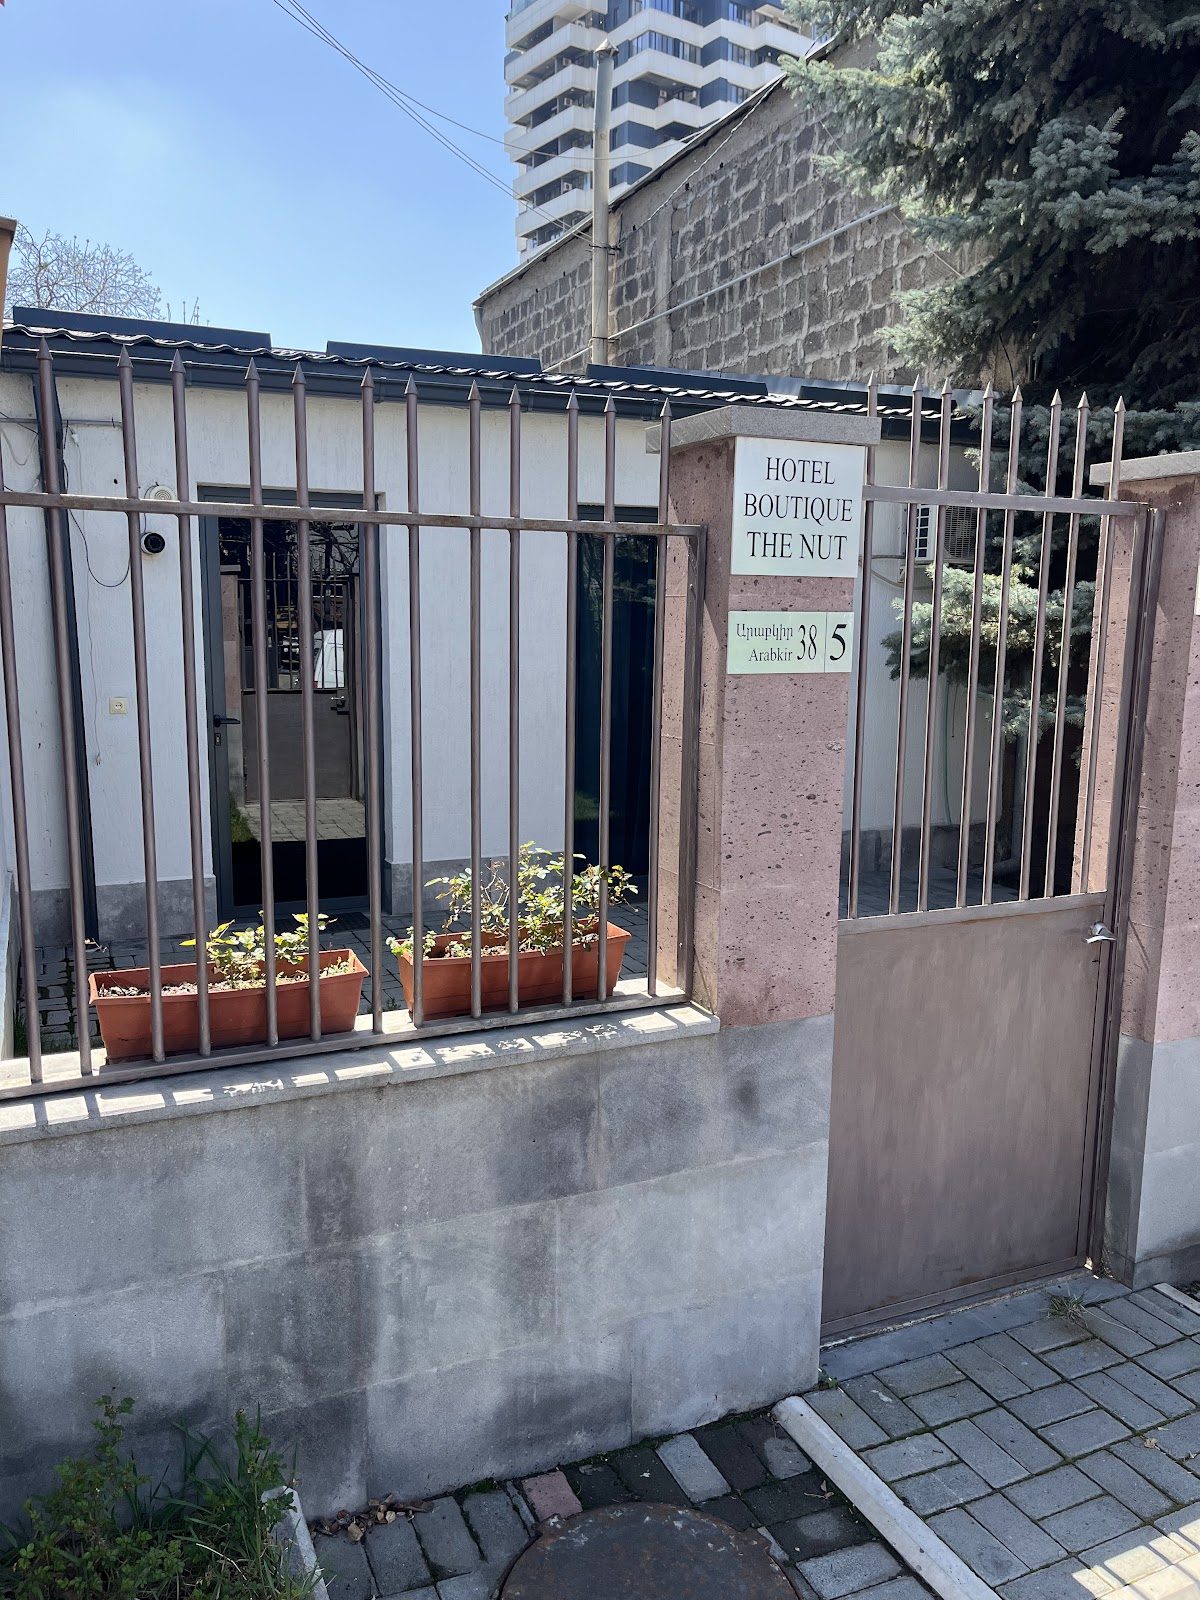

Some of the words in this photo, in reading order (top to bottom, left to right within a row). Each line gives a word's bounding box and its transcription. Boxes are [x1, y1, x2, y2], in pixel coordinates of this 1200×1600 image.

[765, 456, 835, 485] HOTEL
[744, 492, 853, 526] BOUTIQUE
[747, 531, 793, 559] THE
[800, 533, 848, 560] NUT
[736, 623, 793, 641] Արաբկիր
[796, 624, 818, 661] 38
[829, 623, 848, 661] 5
[748, 647, 793, 662] Arabkir
